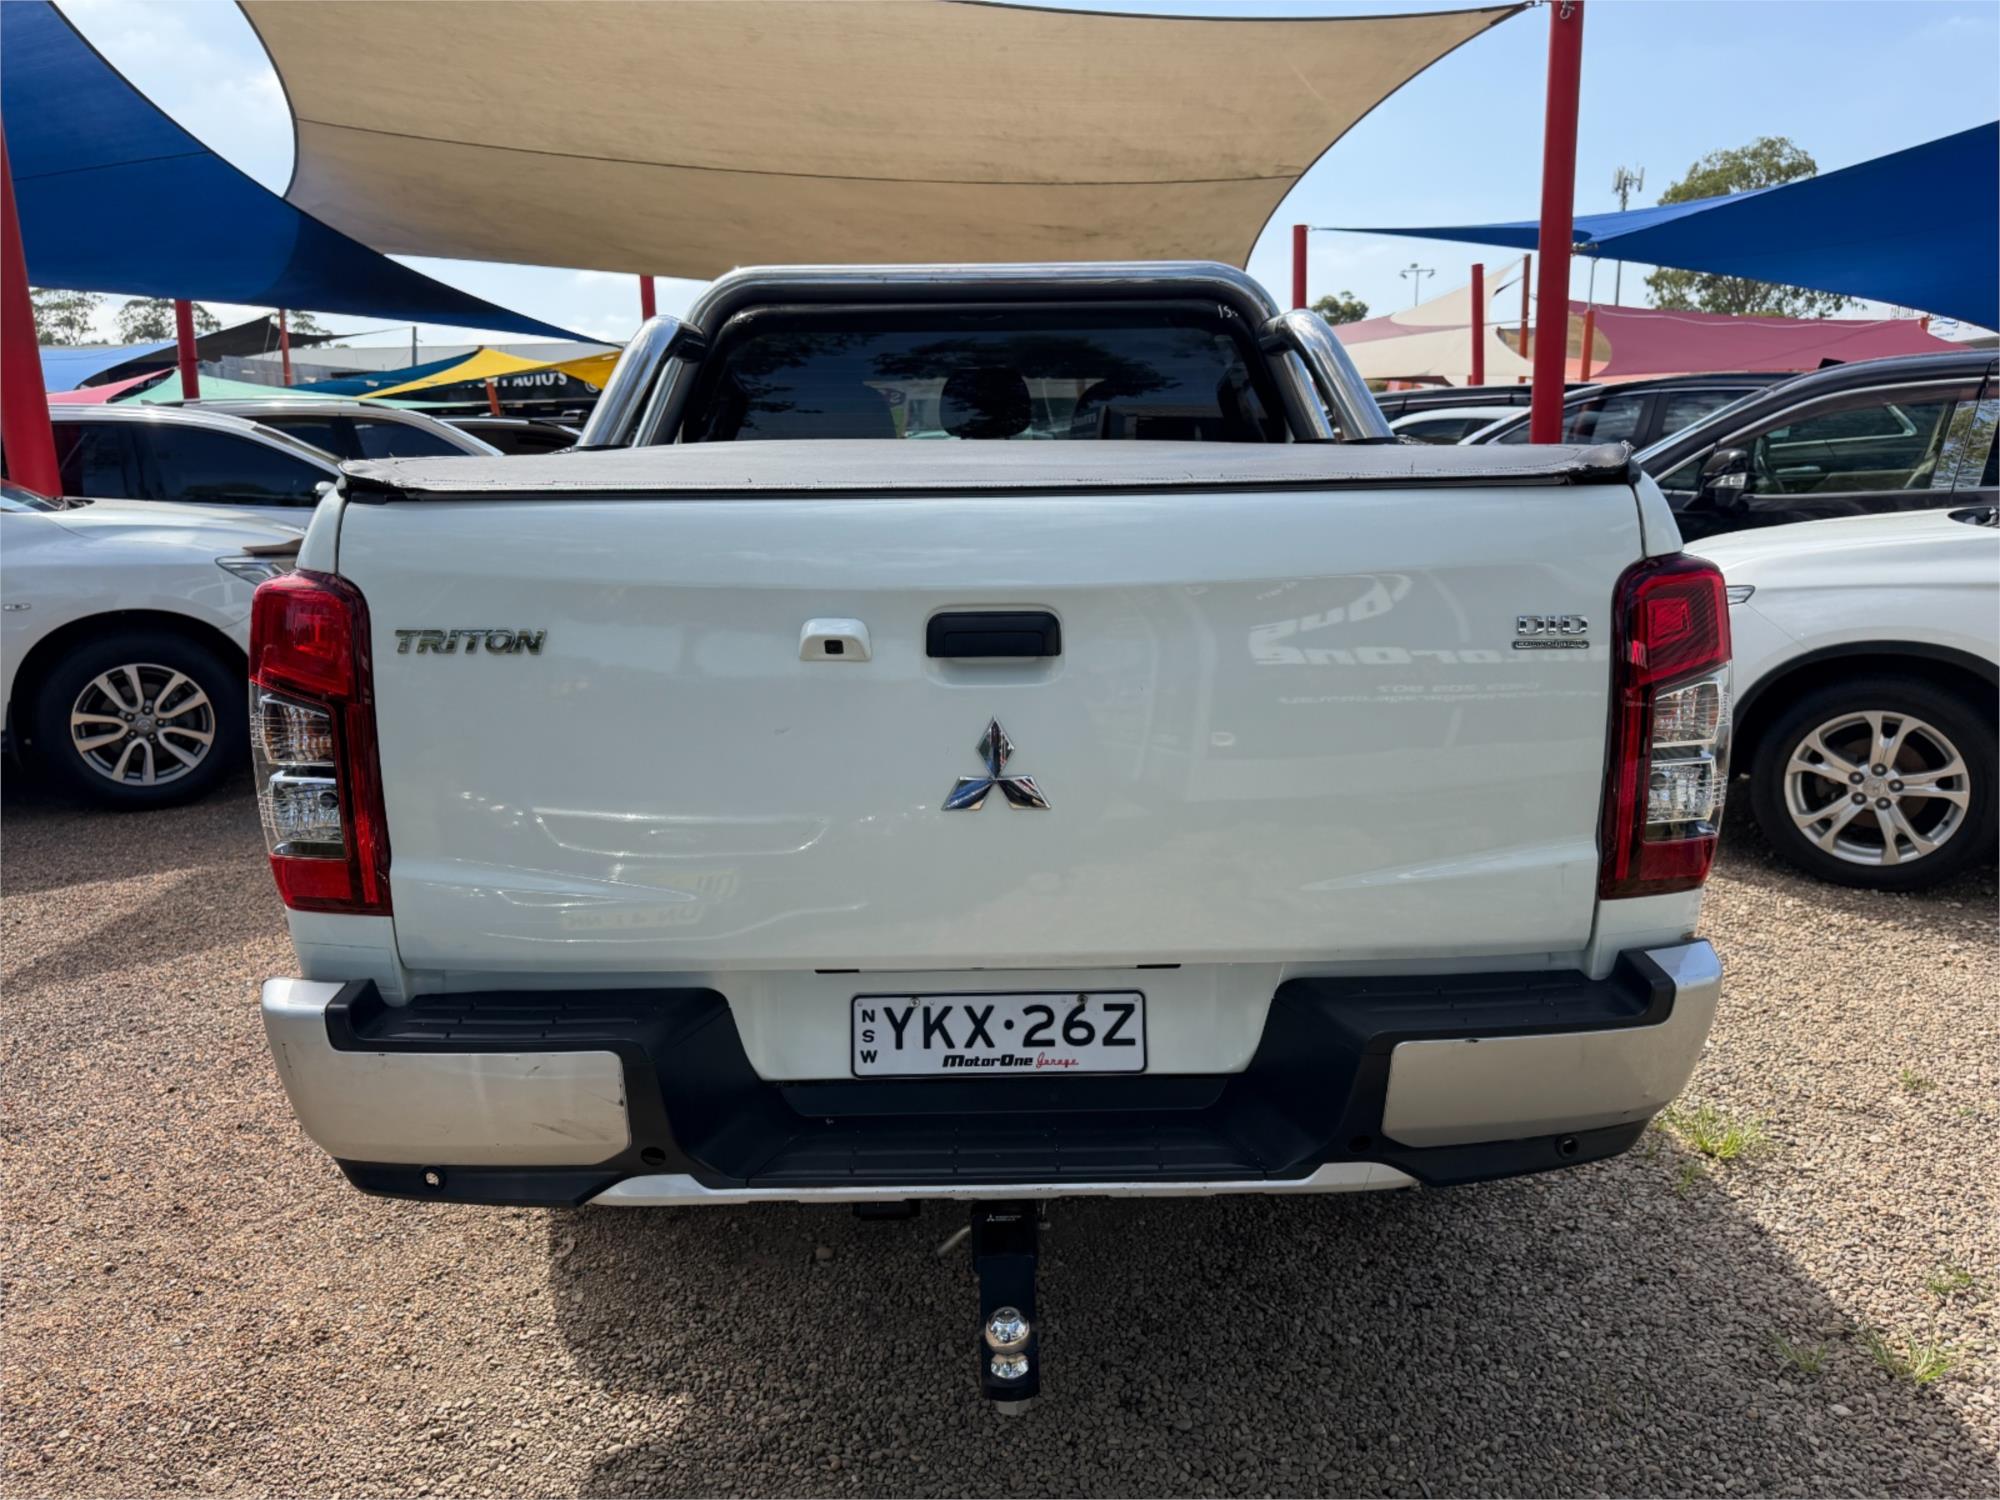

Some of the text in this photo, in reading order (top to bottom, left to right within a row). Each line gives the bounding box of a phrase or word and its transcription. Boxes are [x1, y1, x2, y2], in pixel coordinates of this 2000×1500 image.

[395, 628, 547, 655] TRITON
[860, 1008, 878, 1064] NSW
[942, 1052, 1079, 1068] MotorOne Garage
